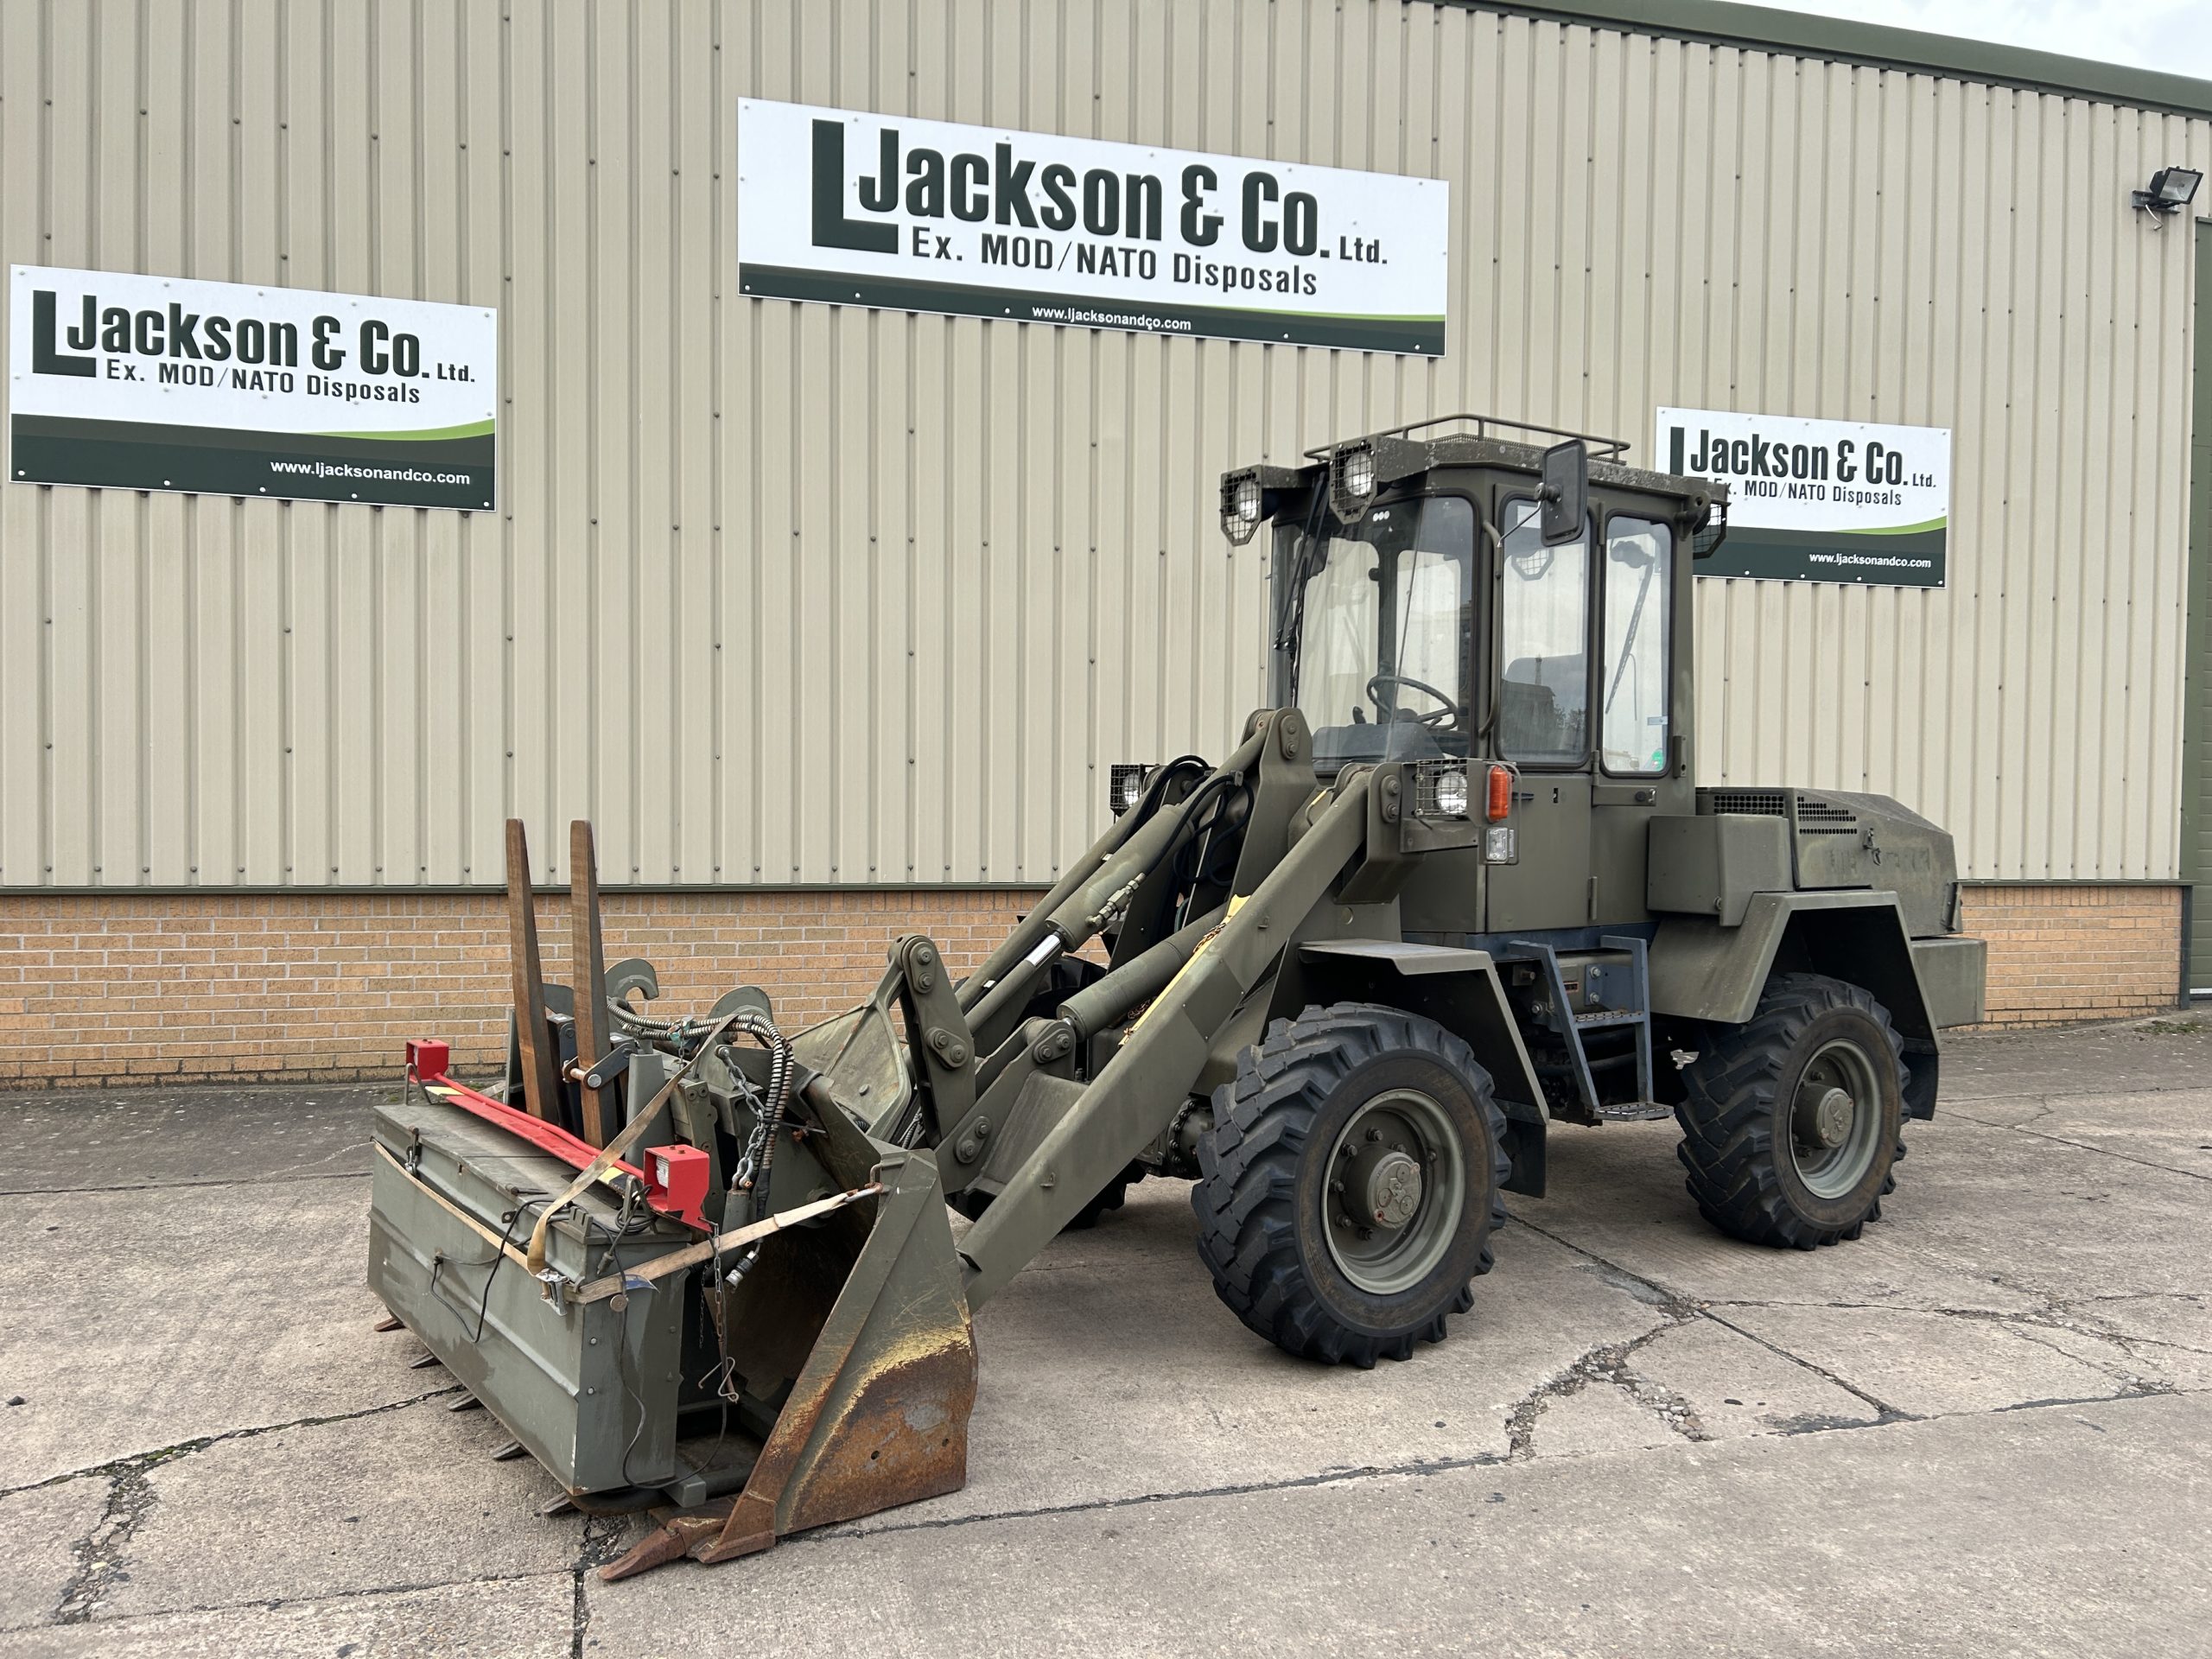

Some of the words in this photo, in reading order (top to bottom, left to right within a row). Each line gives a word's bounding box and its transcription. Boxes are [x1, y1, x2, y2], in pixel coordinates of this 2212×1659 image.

[1181, 165, 1224, 246] &
[1243, 172, 1330, 258] Co.
[1340, 236, 1388, 264] Ltd.
[913, 226, 963, 262] Ex.
[982, 233, 1156, 280] MOD/NATO
[1174, 253, 1317, 296] Disposals
[1033, 307, 1192, 331] www.ljacksonandco.com
[312, 316, 346, 371] &
[360, 321, 430, 378] Co.
[438, 363, 475, 383] Ltd.
[107, 359, 145, 382] Ex.
[159, 363, 294, 393] MOD/NATO
[308, 375, 420, 404] Disposals
[270, 461, 470, 485] www.ljacksonandco.com
[1837, 440, 1858, 482] &
[1866, 442, 1909, 486] Co.
[1913, 473, 1936, 487] Ltd.
[1745, 480, 1826, 501] MOD/NATO
[1833, 486, 1902, 505] Disposals
[1809, 552, 1932, 569] www.ljacksonandco.com
